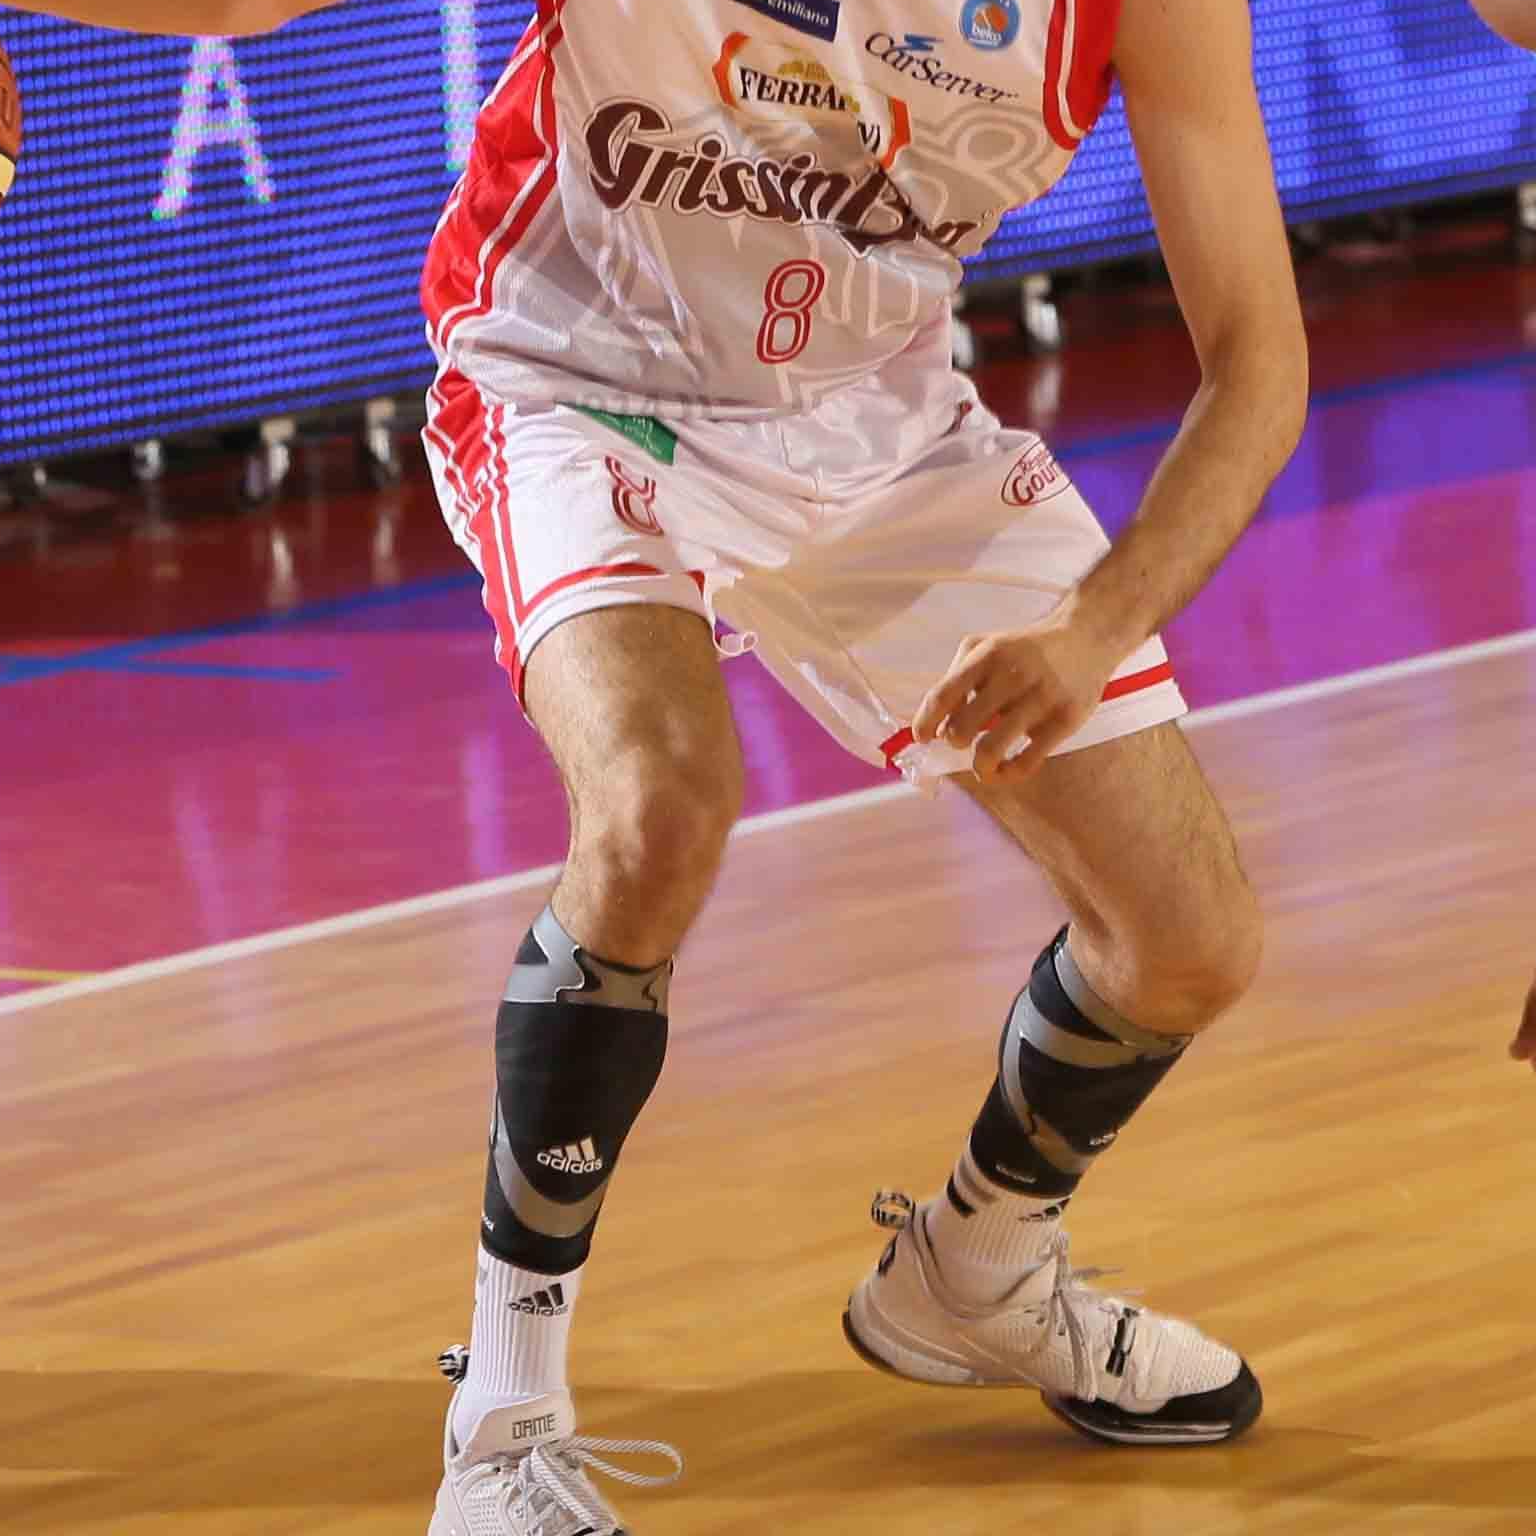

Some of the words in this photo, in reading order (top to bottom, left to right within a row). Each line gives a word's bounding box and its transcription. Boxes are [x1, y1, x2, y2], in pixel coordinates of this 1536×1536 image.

[864, 31, 1009, 104] CarServer
[755, 258, 826, 366] 8
[536, 1151, 603, 1175] adidas
[507, 1301, 569, 1318] adidas
[511, 1413, 557, 1441] DAME
